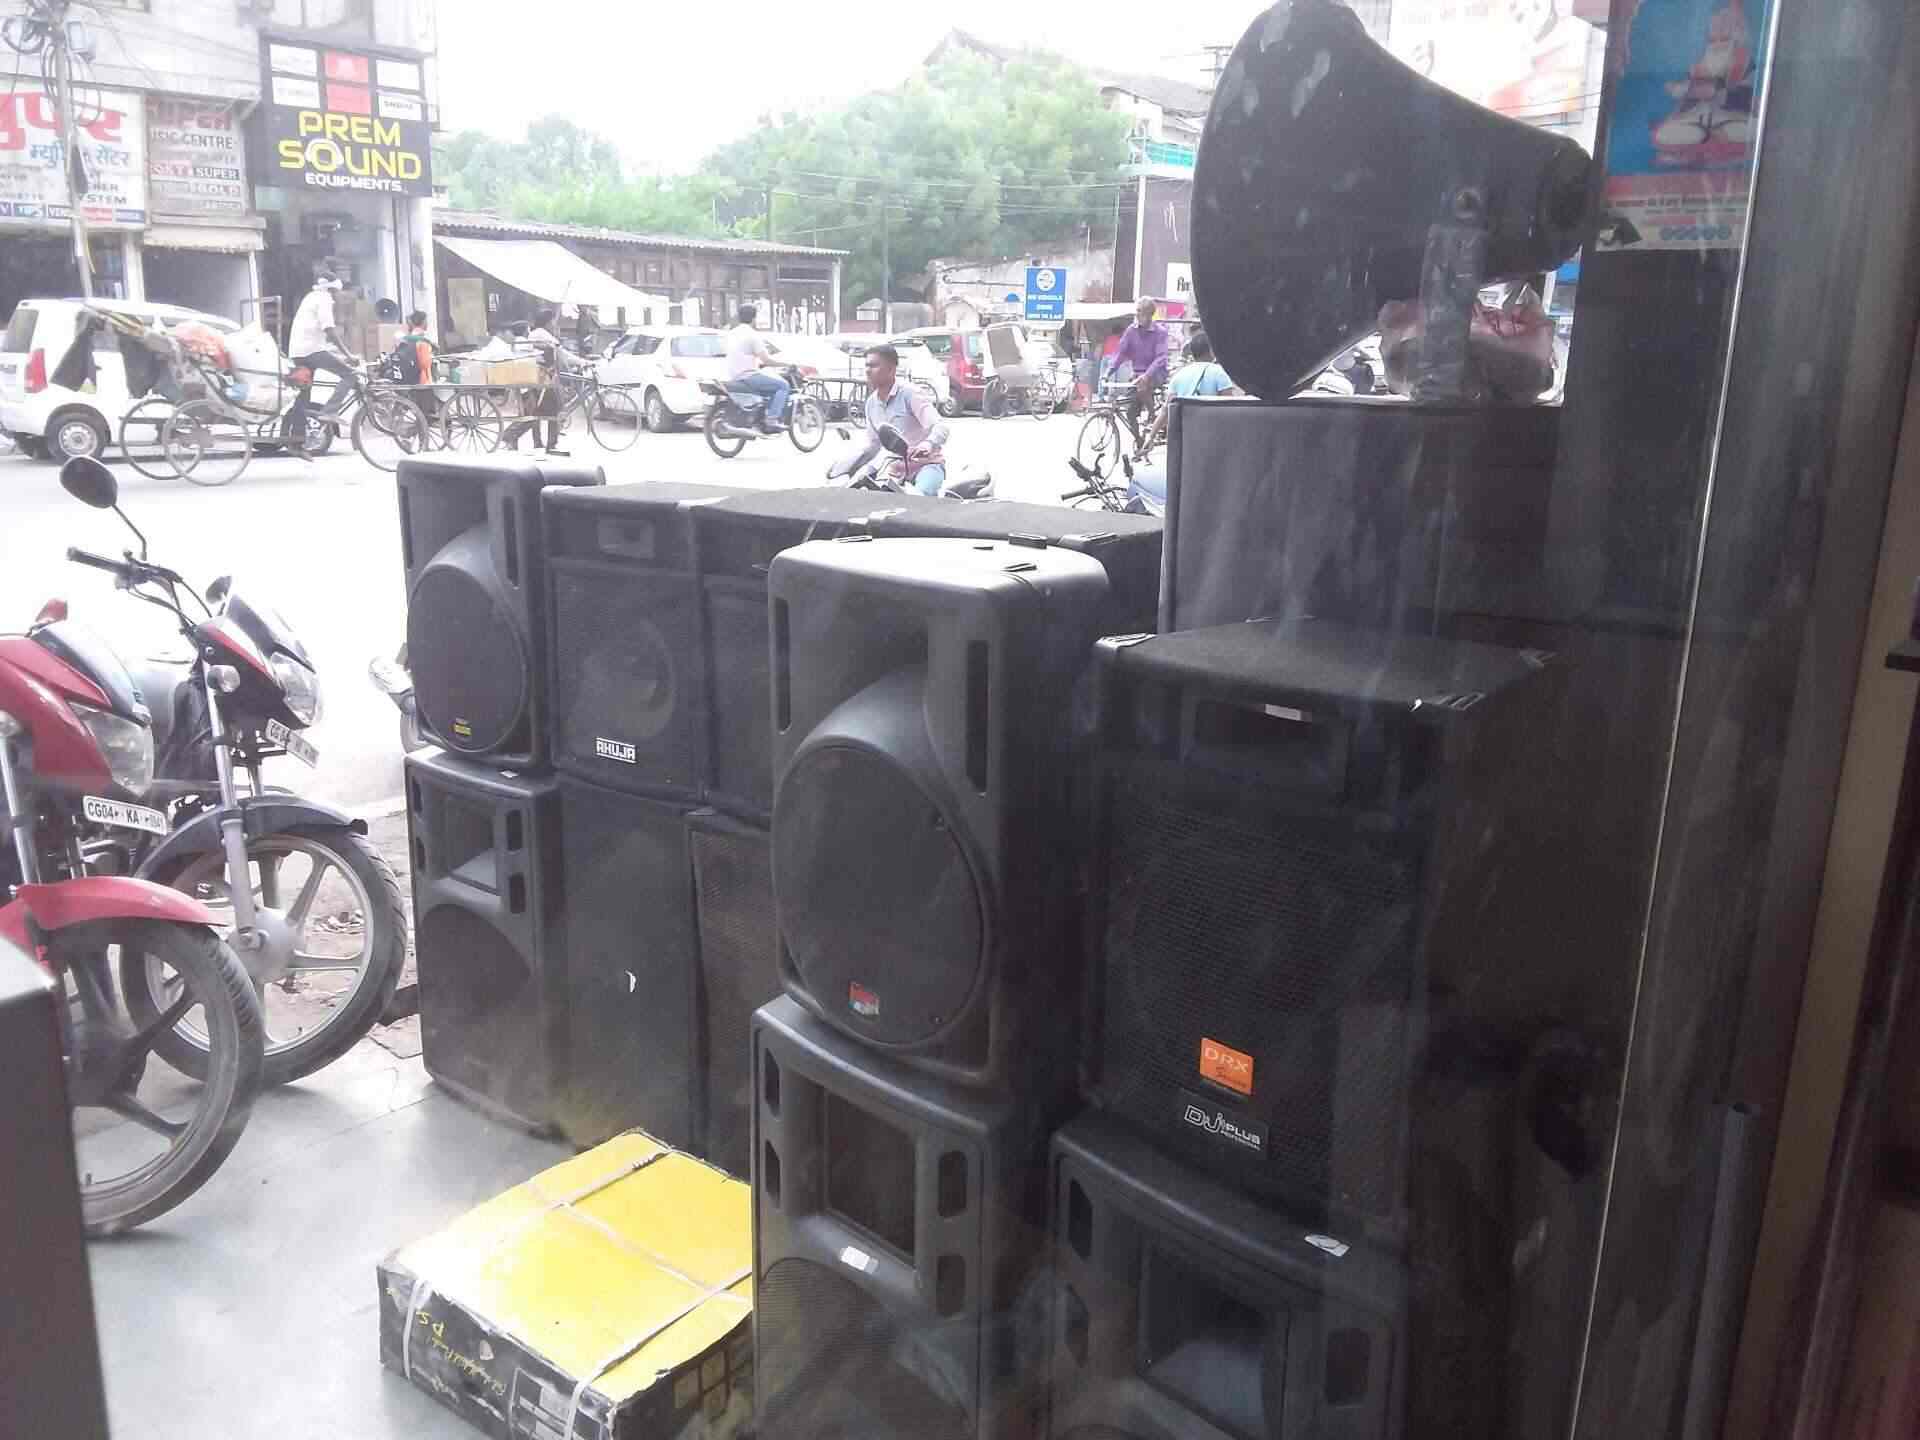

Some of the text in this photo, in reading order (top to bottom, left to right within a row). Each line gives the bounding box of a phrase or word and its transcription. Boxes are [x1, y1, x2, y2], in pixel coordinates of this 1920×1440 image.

[182, 132, 234, 151] CENTRE
[298, 111, 401, 147] PREM
[278, 138, 422, 180] SOUND
[305, 173, 403, 194] EQUIPMENTS
[595, 738, 636, 763] AHUJA
[1205, 1047, 1249, 1073] DRX
